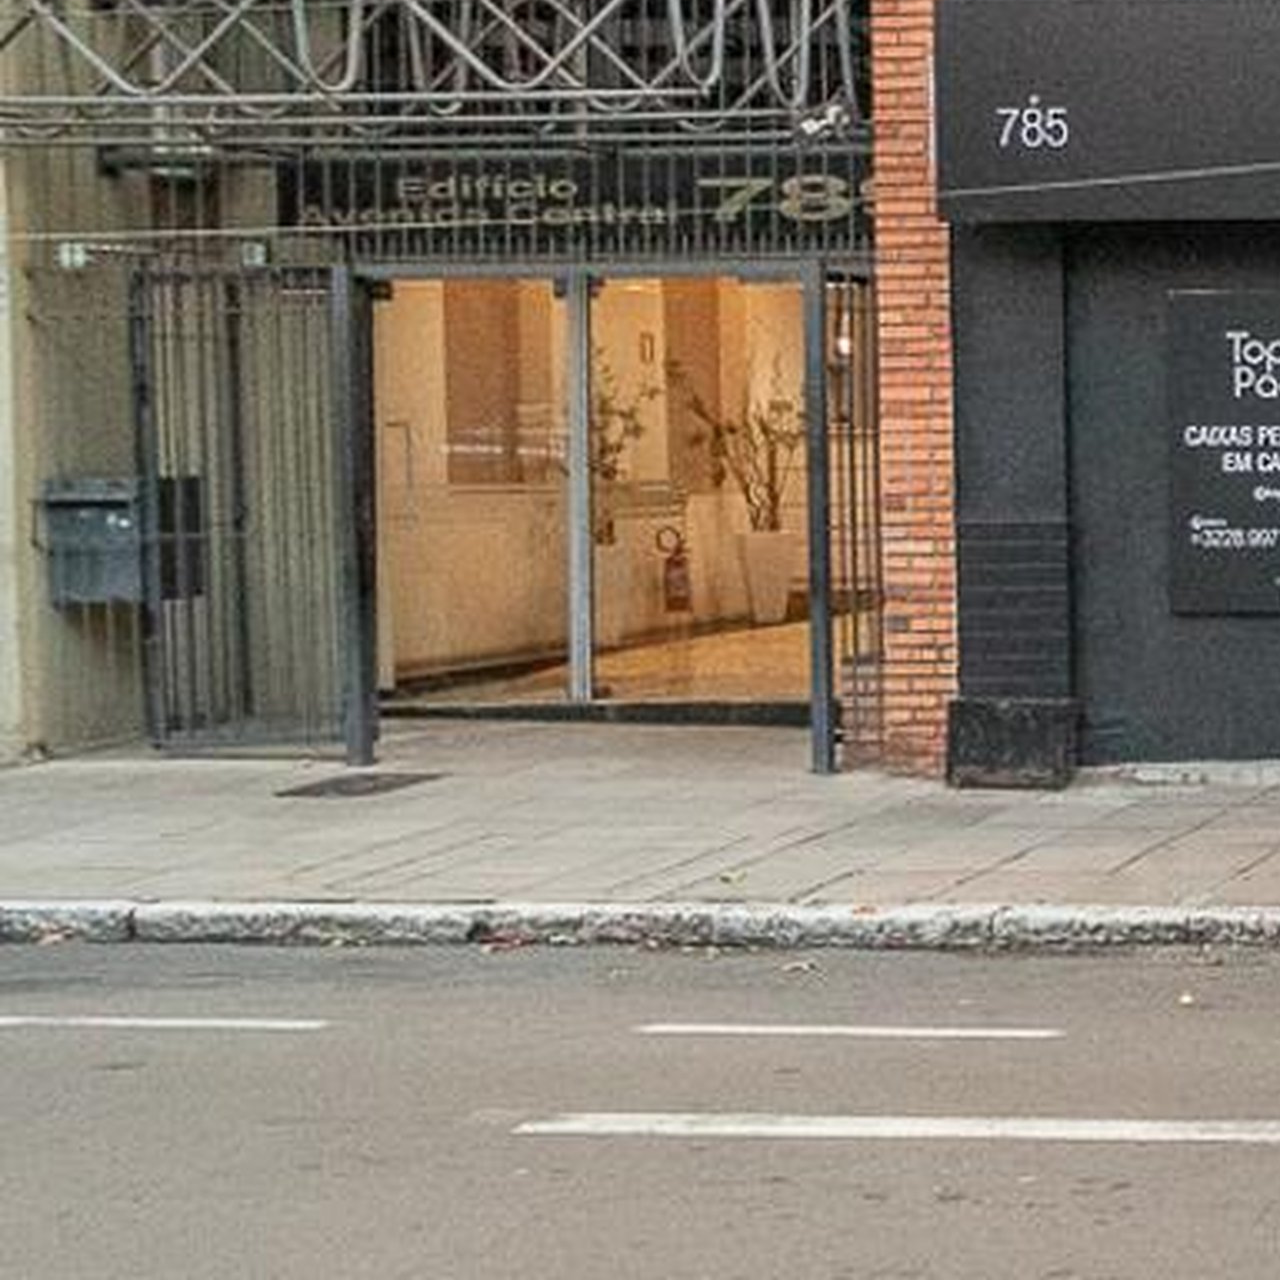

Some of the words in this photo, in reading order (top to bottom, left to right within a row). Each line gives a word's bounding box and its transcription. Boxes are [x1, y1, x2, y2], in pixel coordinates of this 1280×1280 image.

[996, 107, 1068, 147] 785
[696, 174, 876, 222] 78
[1184, 425, 1253, 448] CAIXAS
[1222, 452, 1253, 472] EM
